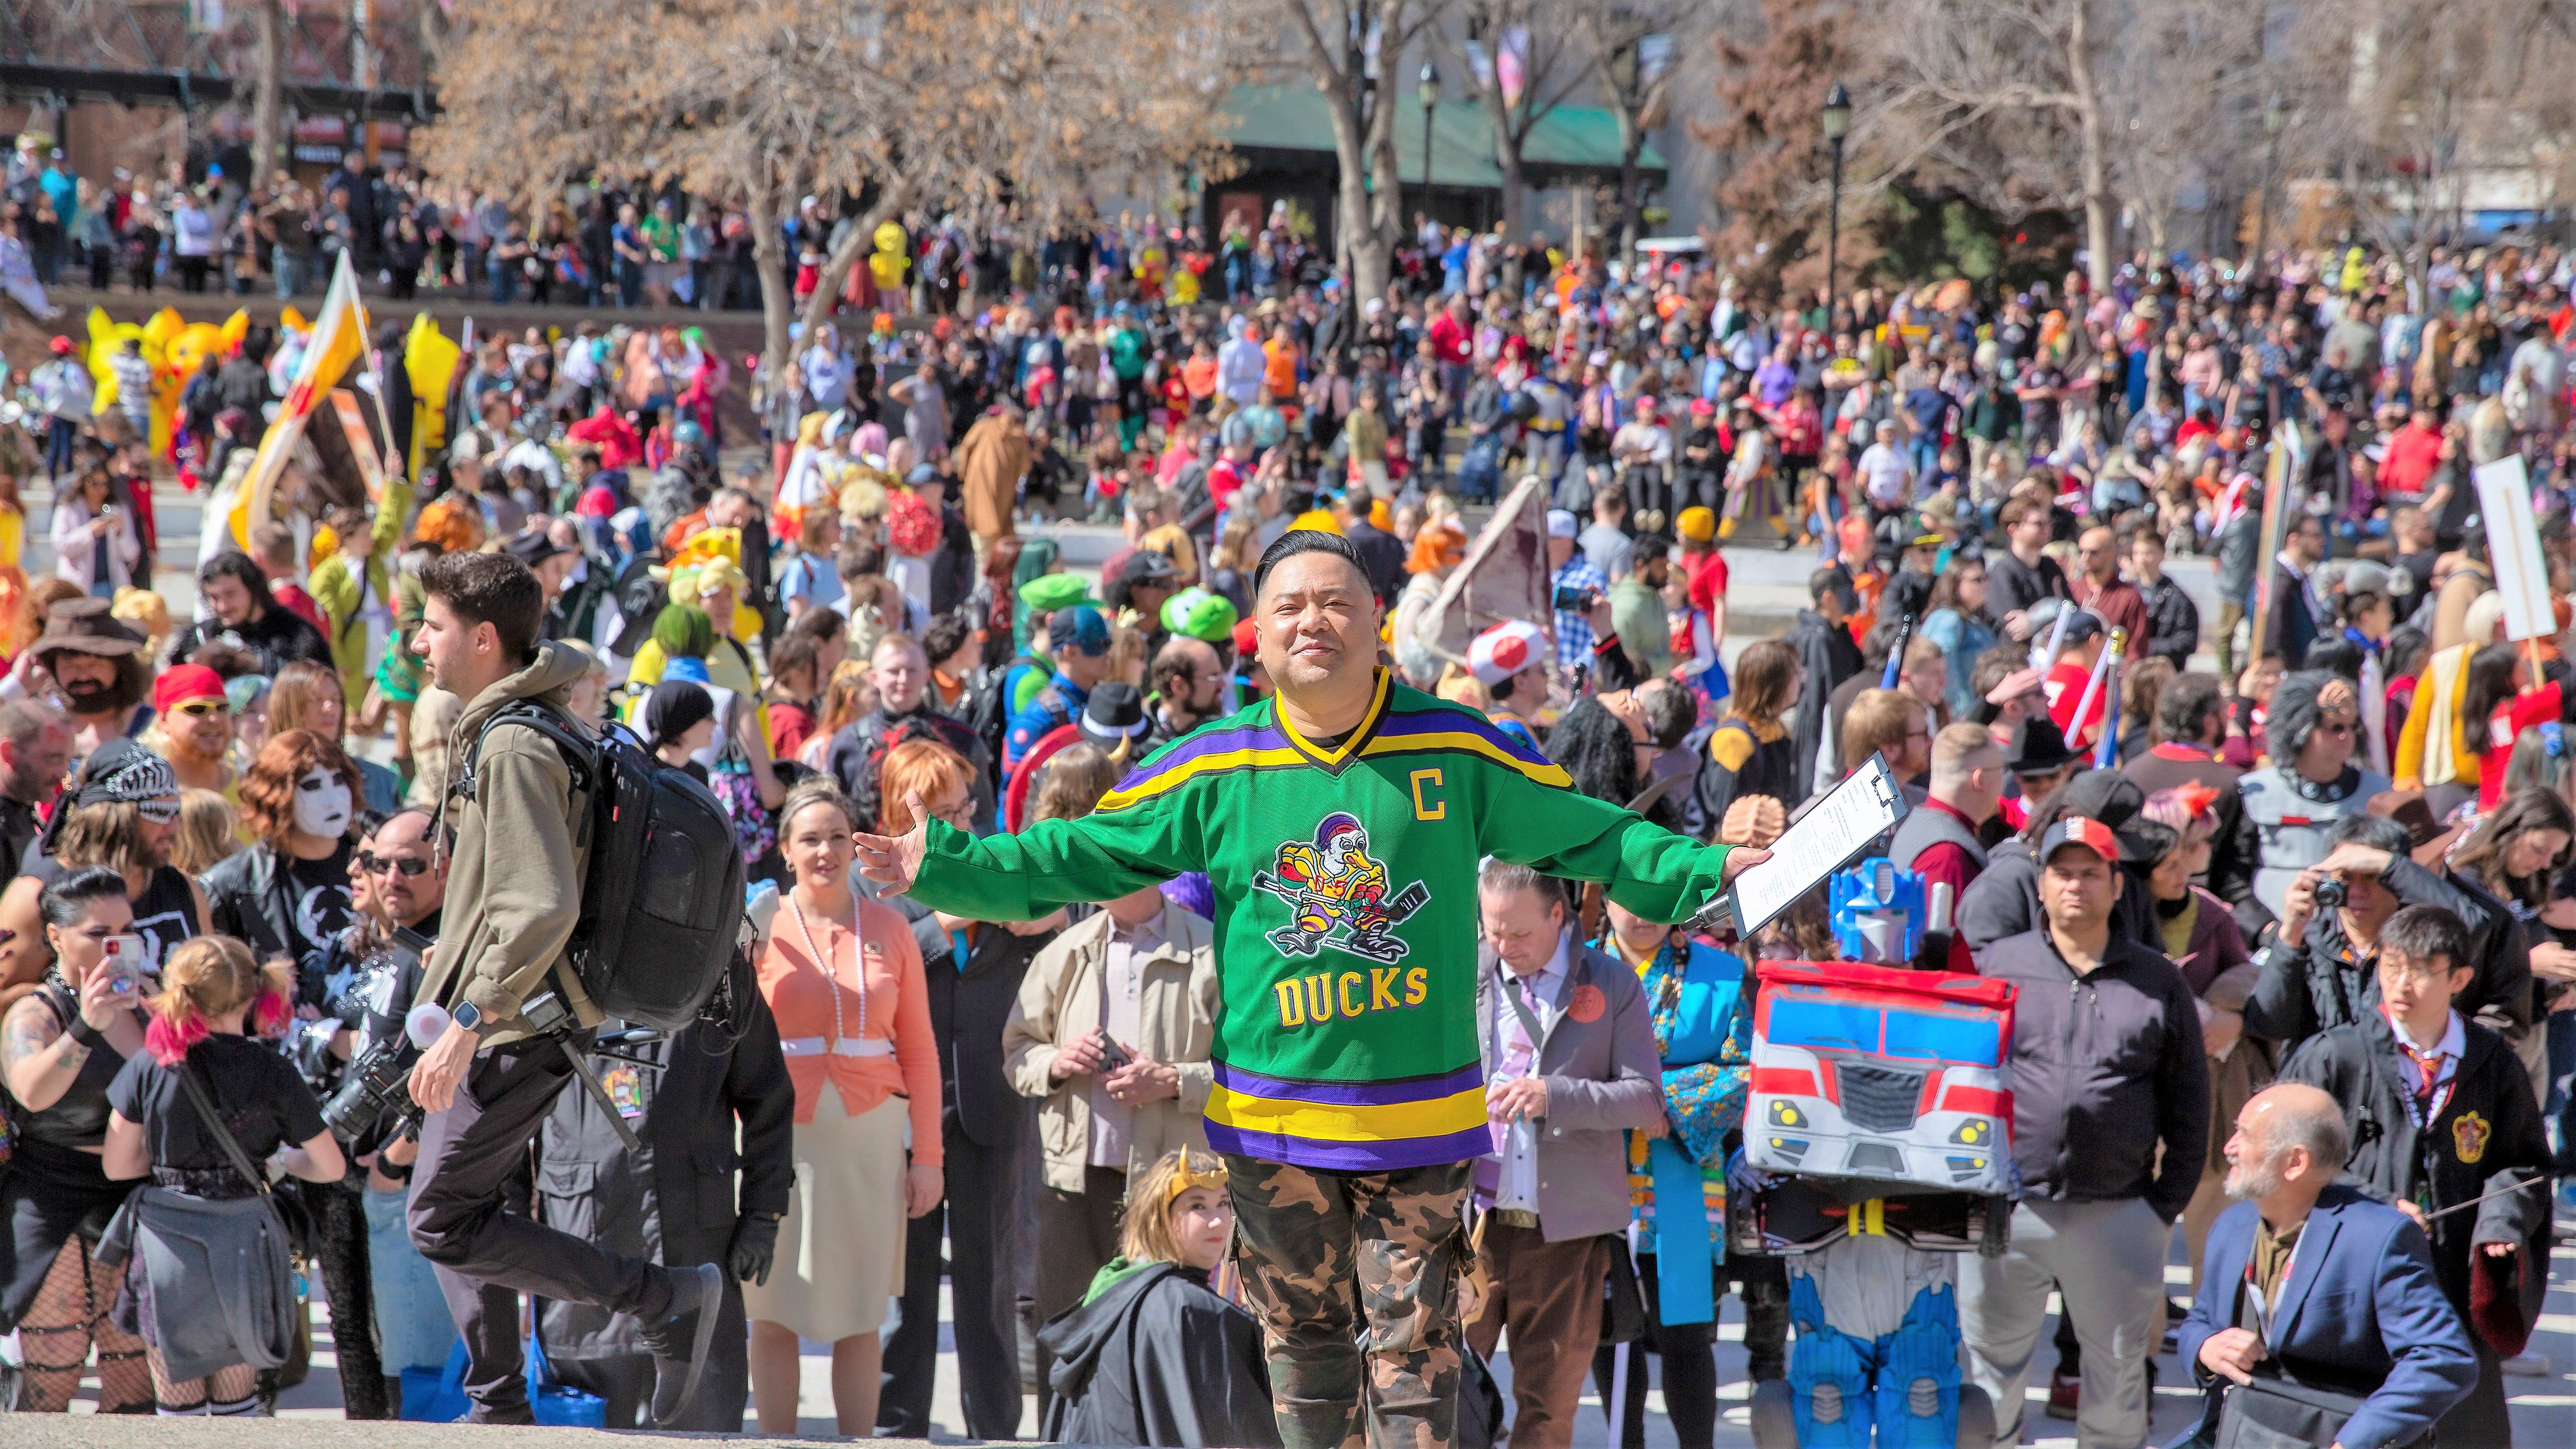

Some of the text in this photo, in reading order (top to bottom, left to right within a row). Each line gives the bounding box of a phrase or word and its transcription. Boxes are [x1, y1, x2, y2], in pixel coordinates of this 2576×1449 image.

[1409, 767, 1445, 821] C
[1314, 875, 1348, 897] D-5
[1274, 967, 1427, 1027] DUCKS
